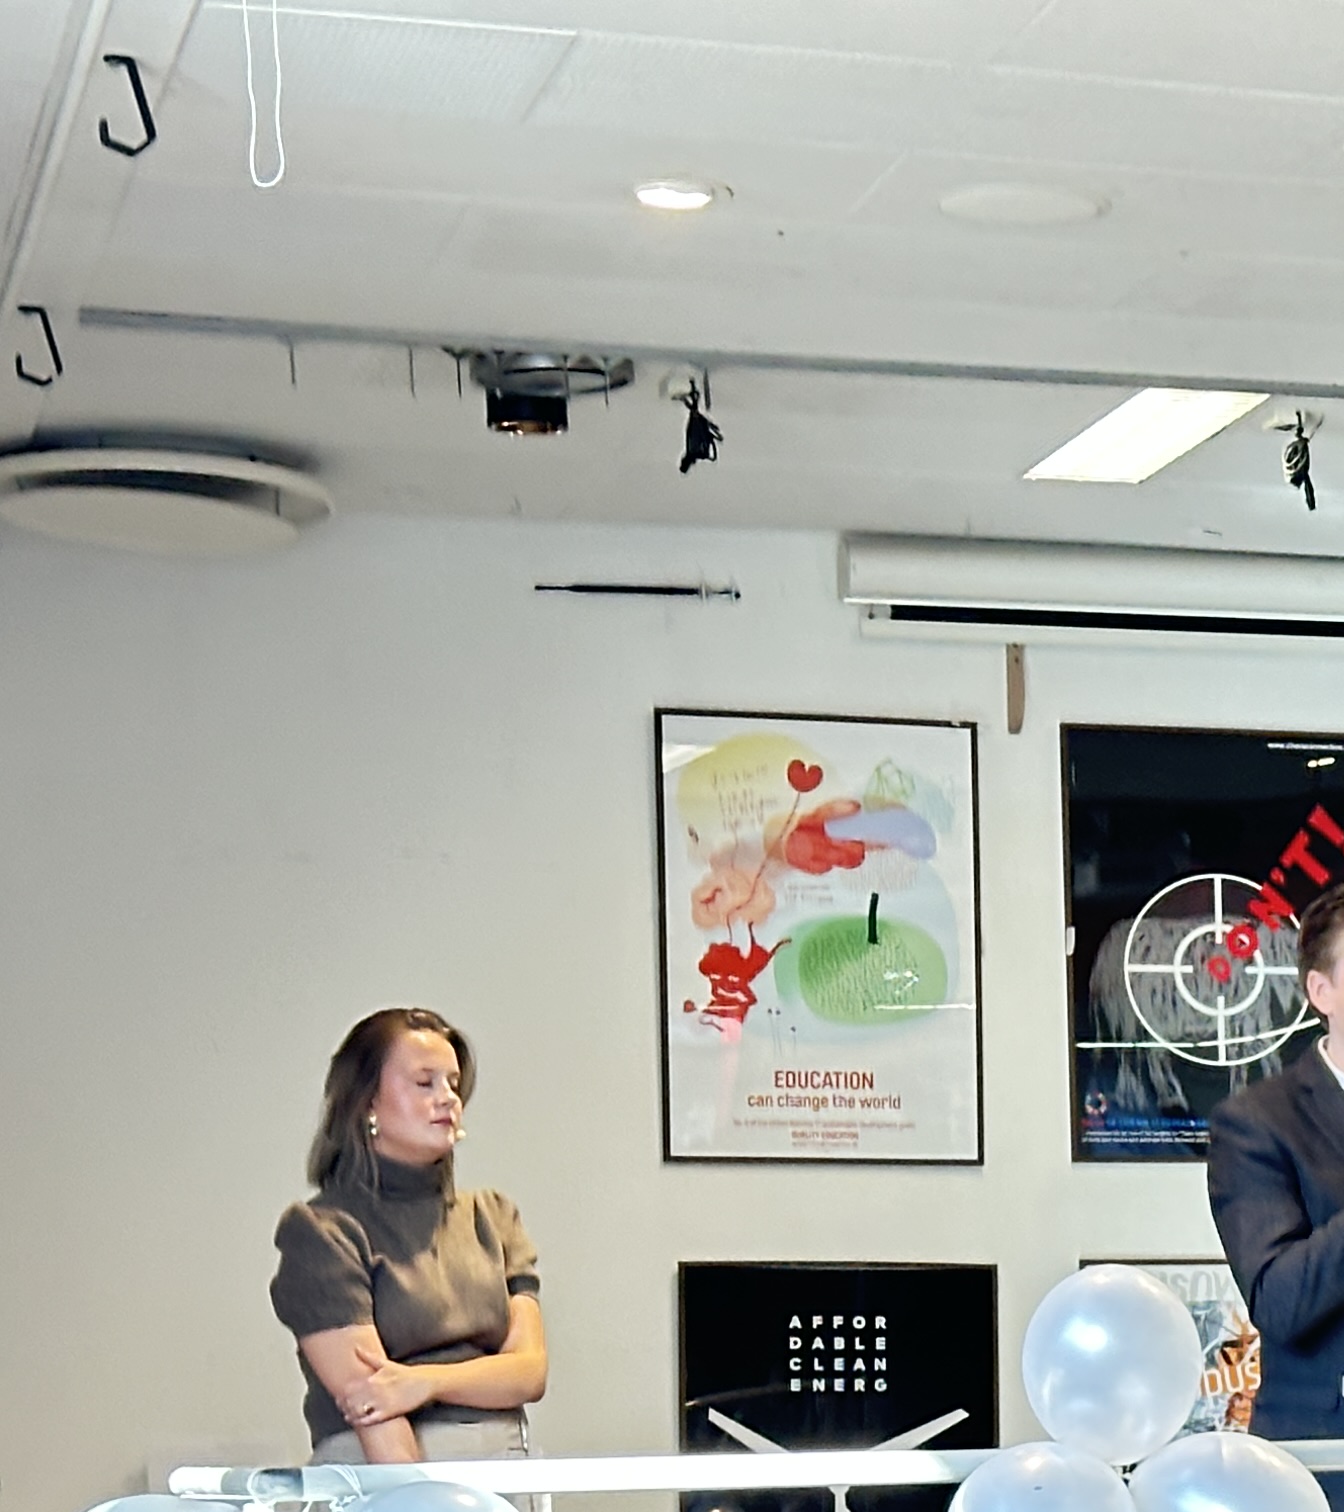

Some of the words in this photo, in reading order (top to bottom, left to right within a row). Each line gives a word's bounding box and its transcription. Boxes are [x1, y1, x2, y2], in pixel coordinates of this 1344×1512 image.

[774, 1070, 875, 1090] EDUCATION
[747, 1095, 773, 1109] can
[777, 1093, 829, 1112] change
[833, 1093, 856, 1108] the
[859, 1094, 901, 1110] world
[788, 1315, 887, 1329] AFFOR
[789, 1336, 887, 1350] DABLE
[789, 1357, 887, 1371] CLEAN
[790, 1378, 888, 1392] ENERG
[1203, 1361, 1261, 1398] DUS
